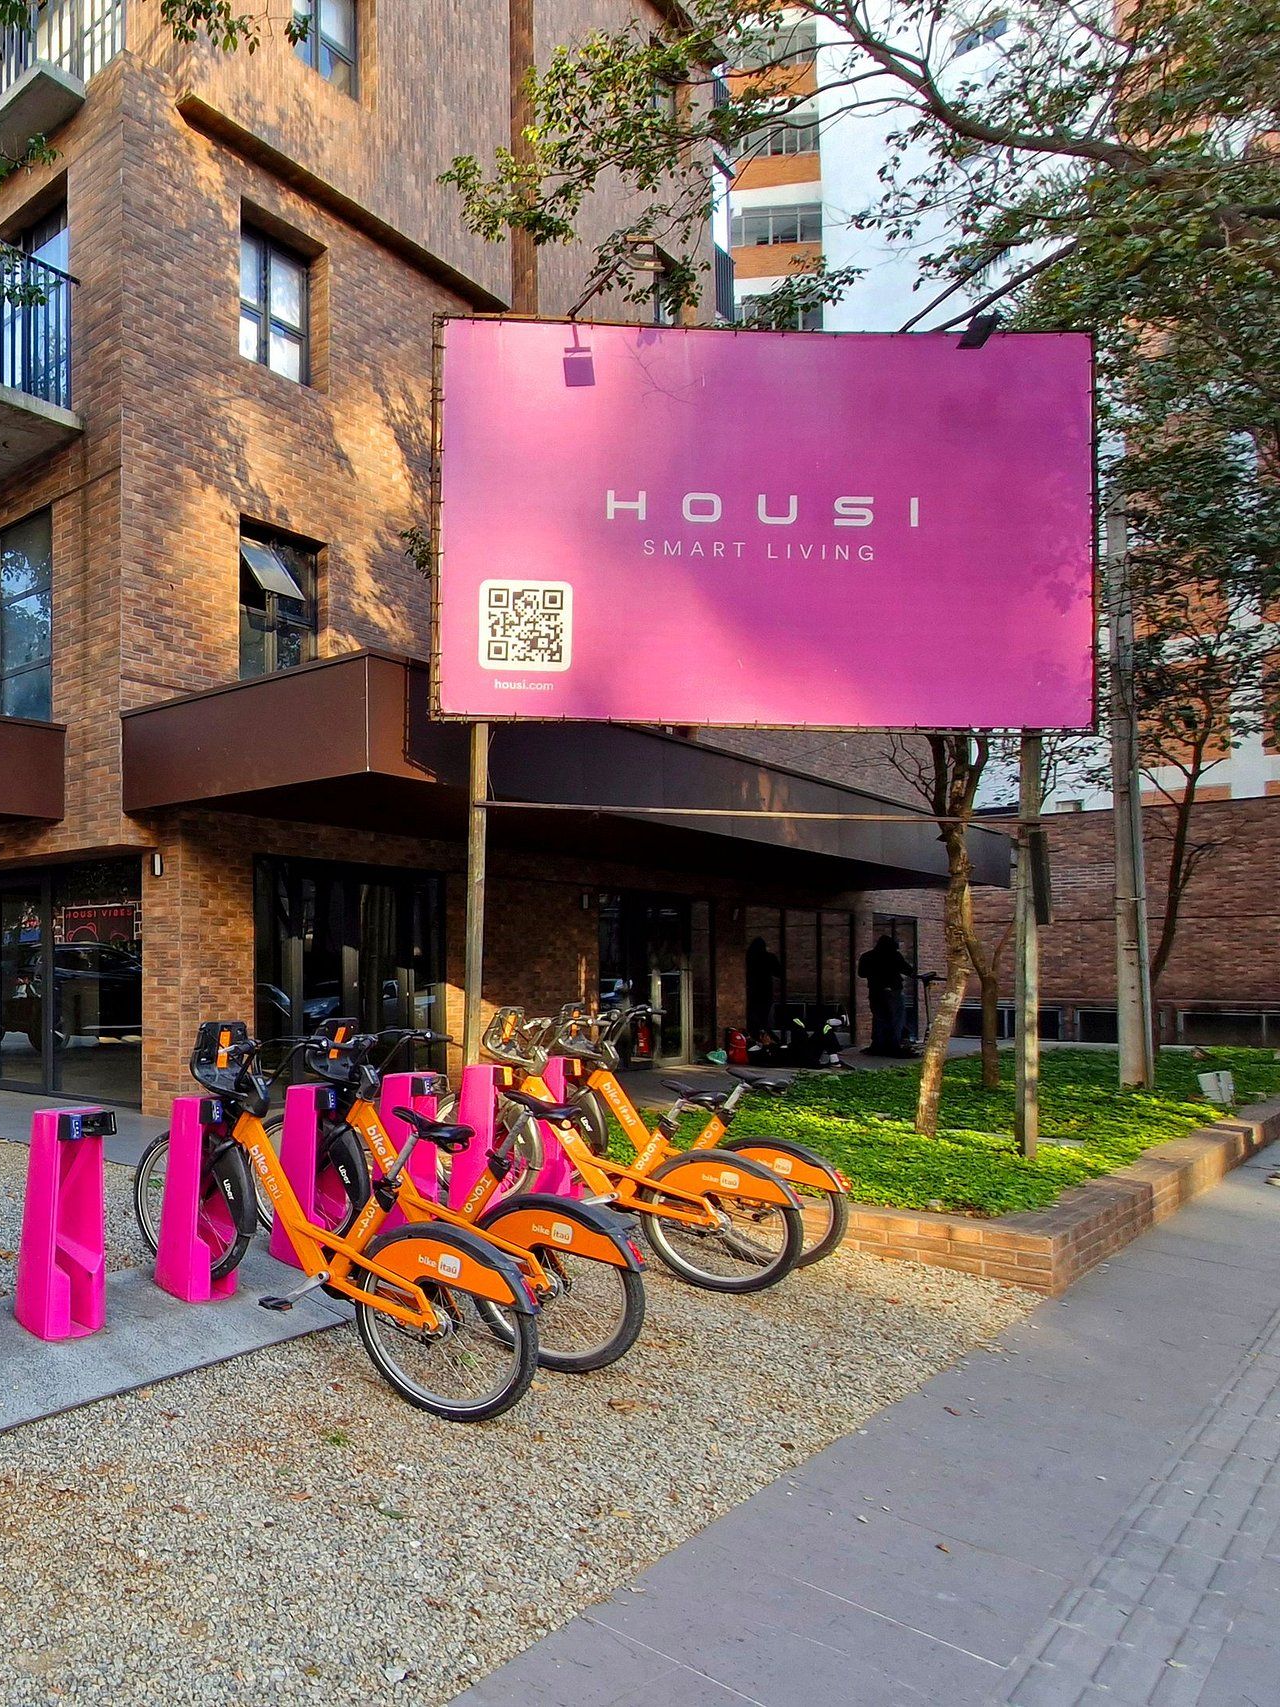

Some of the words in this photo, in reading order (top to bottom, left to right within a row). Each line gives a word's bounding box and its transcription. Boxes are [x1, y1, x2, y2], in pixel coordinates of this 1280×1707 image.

[606, 489, 919, 528] HOUSI
[643, 539, 746, 558] SMART
[767, 543, 874, 561] LIVING
[494, 679, 554, 691] housi.com
[602, 1081, 621, 1105] bike
[366, 1124, 387, 1156] bike
[249, 1144, 269, 1175] bike
[266, 1175, 284, 1200] itaú
[338, 1165, 351, 1185] Uber
[223, 1179, 235, 1200] Uber
[532, 1223, 551, 1236] bike
[418, 1254, 437, 1268] bike
[440, 1261, 457, 1275] itaú
